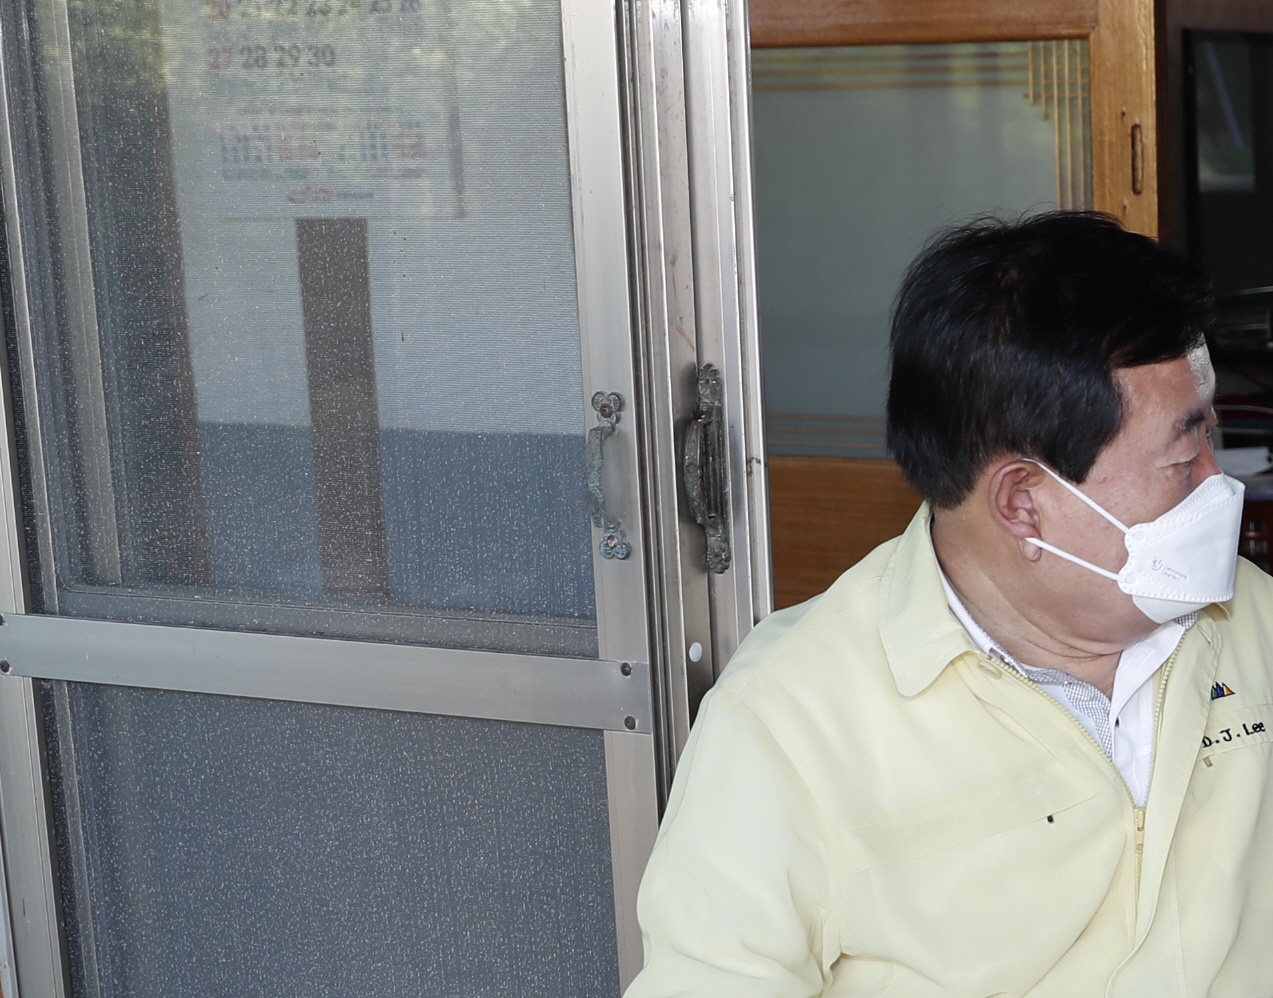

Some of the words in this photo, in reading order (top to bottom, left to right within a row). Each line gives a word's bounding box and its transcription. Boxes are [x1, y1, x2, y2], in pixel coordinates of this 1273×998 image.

[206, 46, 234, 70] 27
[240, 44, 269, 70] 28
[273, 43, 301, 69] 29
[306, 43, 337, 68] 30
